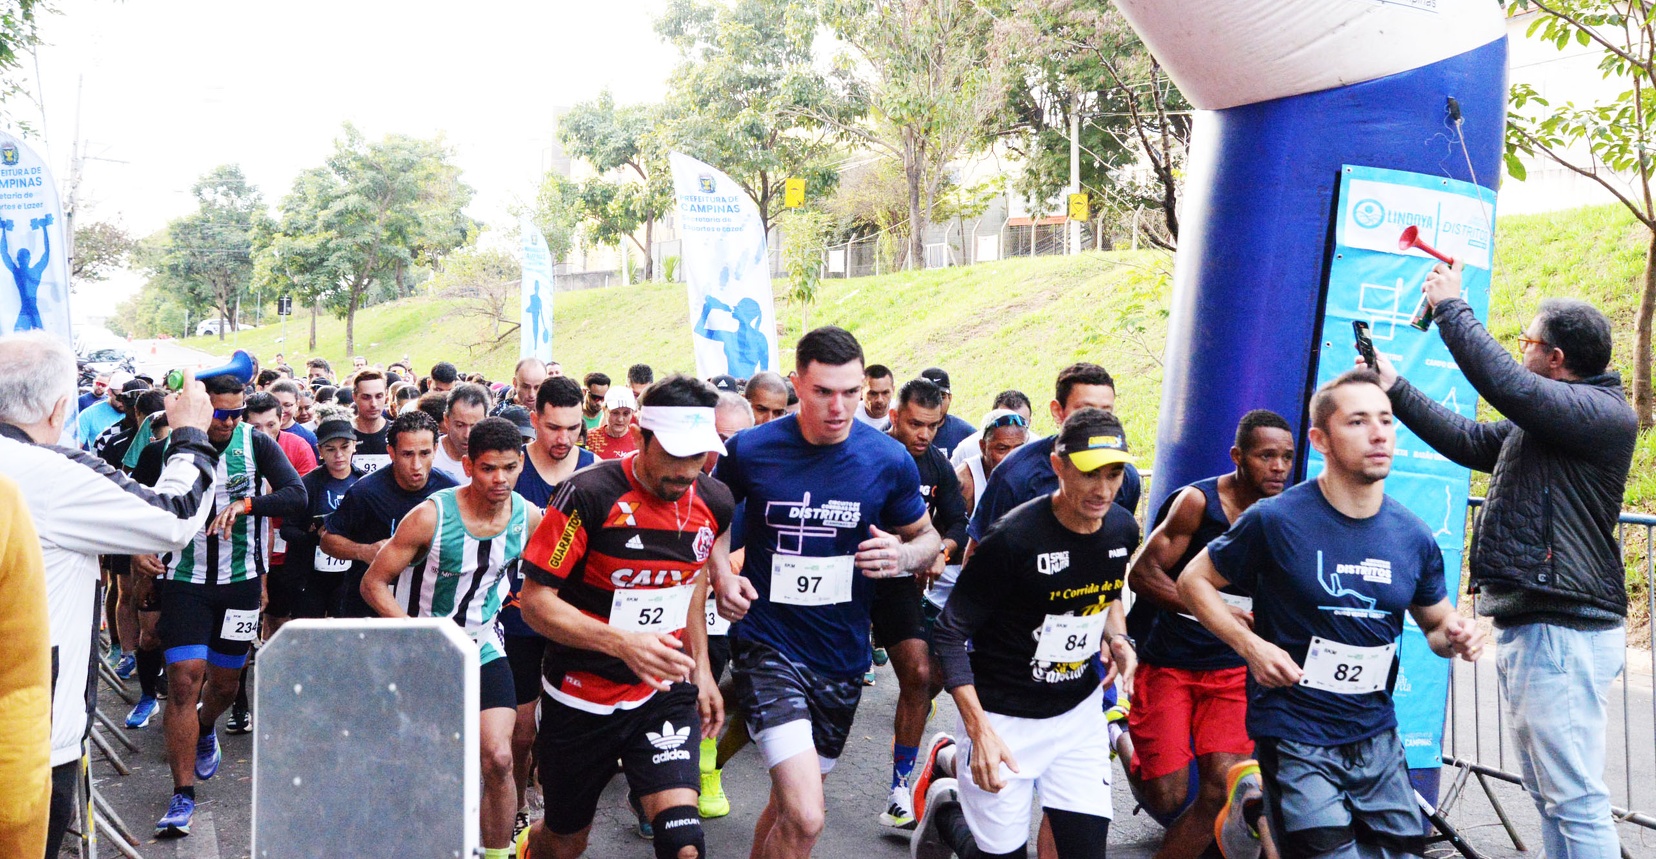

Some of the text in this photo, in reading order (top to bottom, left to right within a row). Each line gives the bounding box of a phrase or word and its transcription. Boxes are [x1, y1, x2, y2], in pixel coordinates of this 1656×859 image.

[680, 195, 727, 203] PREFEITURA
[680, 203, 740, 213] CAMPINAS
[1387, 209, 1433, 229] LINDOYA
[1442, 221, 1488, 242] DISTRITOS
[364, 463, 377, 473] 93
[788, 507, 862, 523] DISTRITOS
[1050, 551, 1069, 563] SPACE
[1336, 563, 1392, 579] DISTRITOS
[797, 576, 822, 593] 97
[1062, 583, 1100, 600] Corrida
[1101, 580, 1113, 592] de
[638, 607, 664, 626] 52
[704, 612, 716, 626] 3
[235, 621, 258, 633] 234
[1065, 634, 1087, 651] 84
[1334, 664, 1362, 681] 82
[652, 750, 690, 764] adidas
